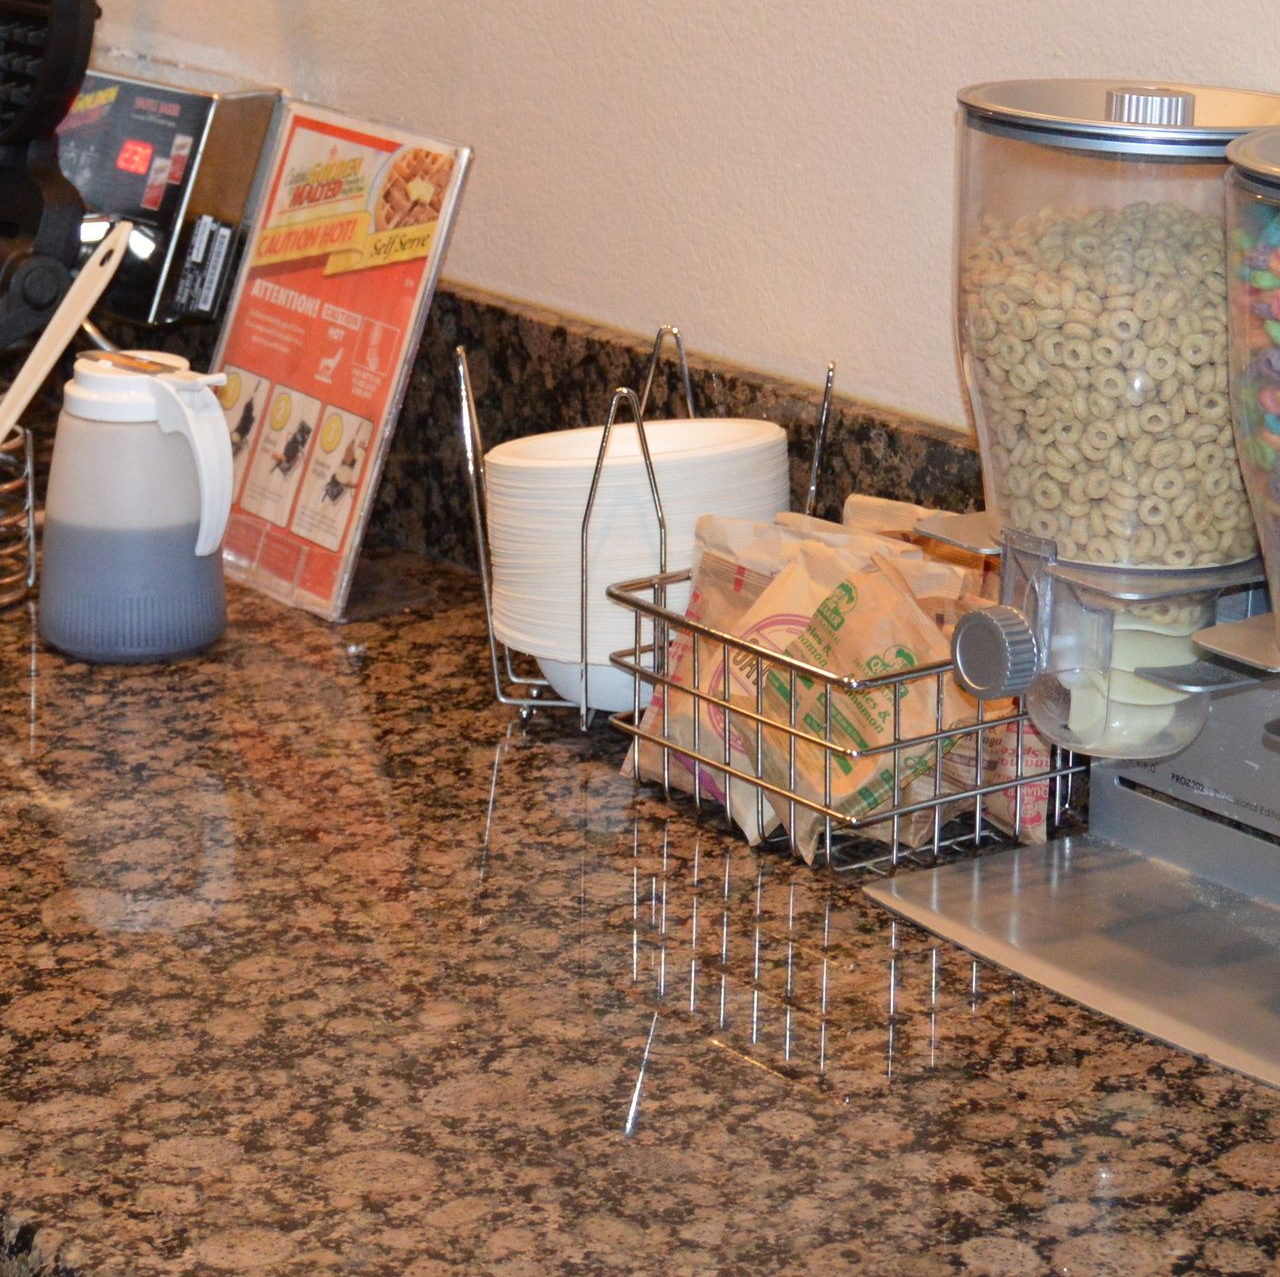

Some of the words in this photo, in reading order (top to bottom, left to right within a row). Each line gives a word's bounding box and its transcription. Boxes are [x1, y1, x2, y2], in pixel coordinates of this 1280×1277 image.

[256, 226, 320, 258] CAUTION
[320, 218, 359, 247] HOT!
[371, 234, 396, 261] Self
[397, 232, 431, 252] Serve
[250, 278, 321, 318] ATTENTION!
[845, 688, 884, 734] nnamon
[1000, 746, 1040, 757] Spce
